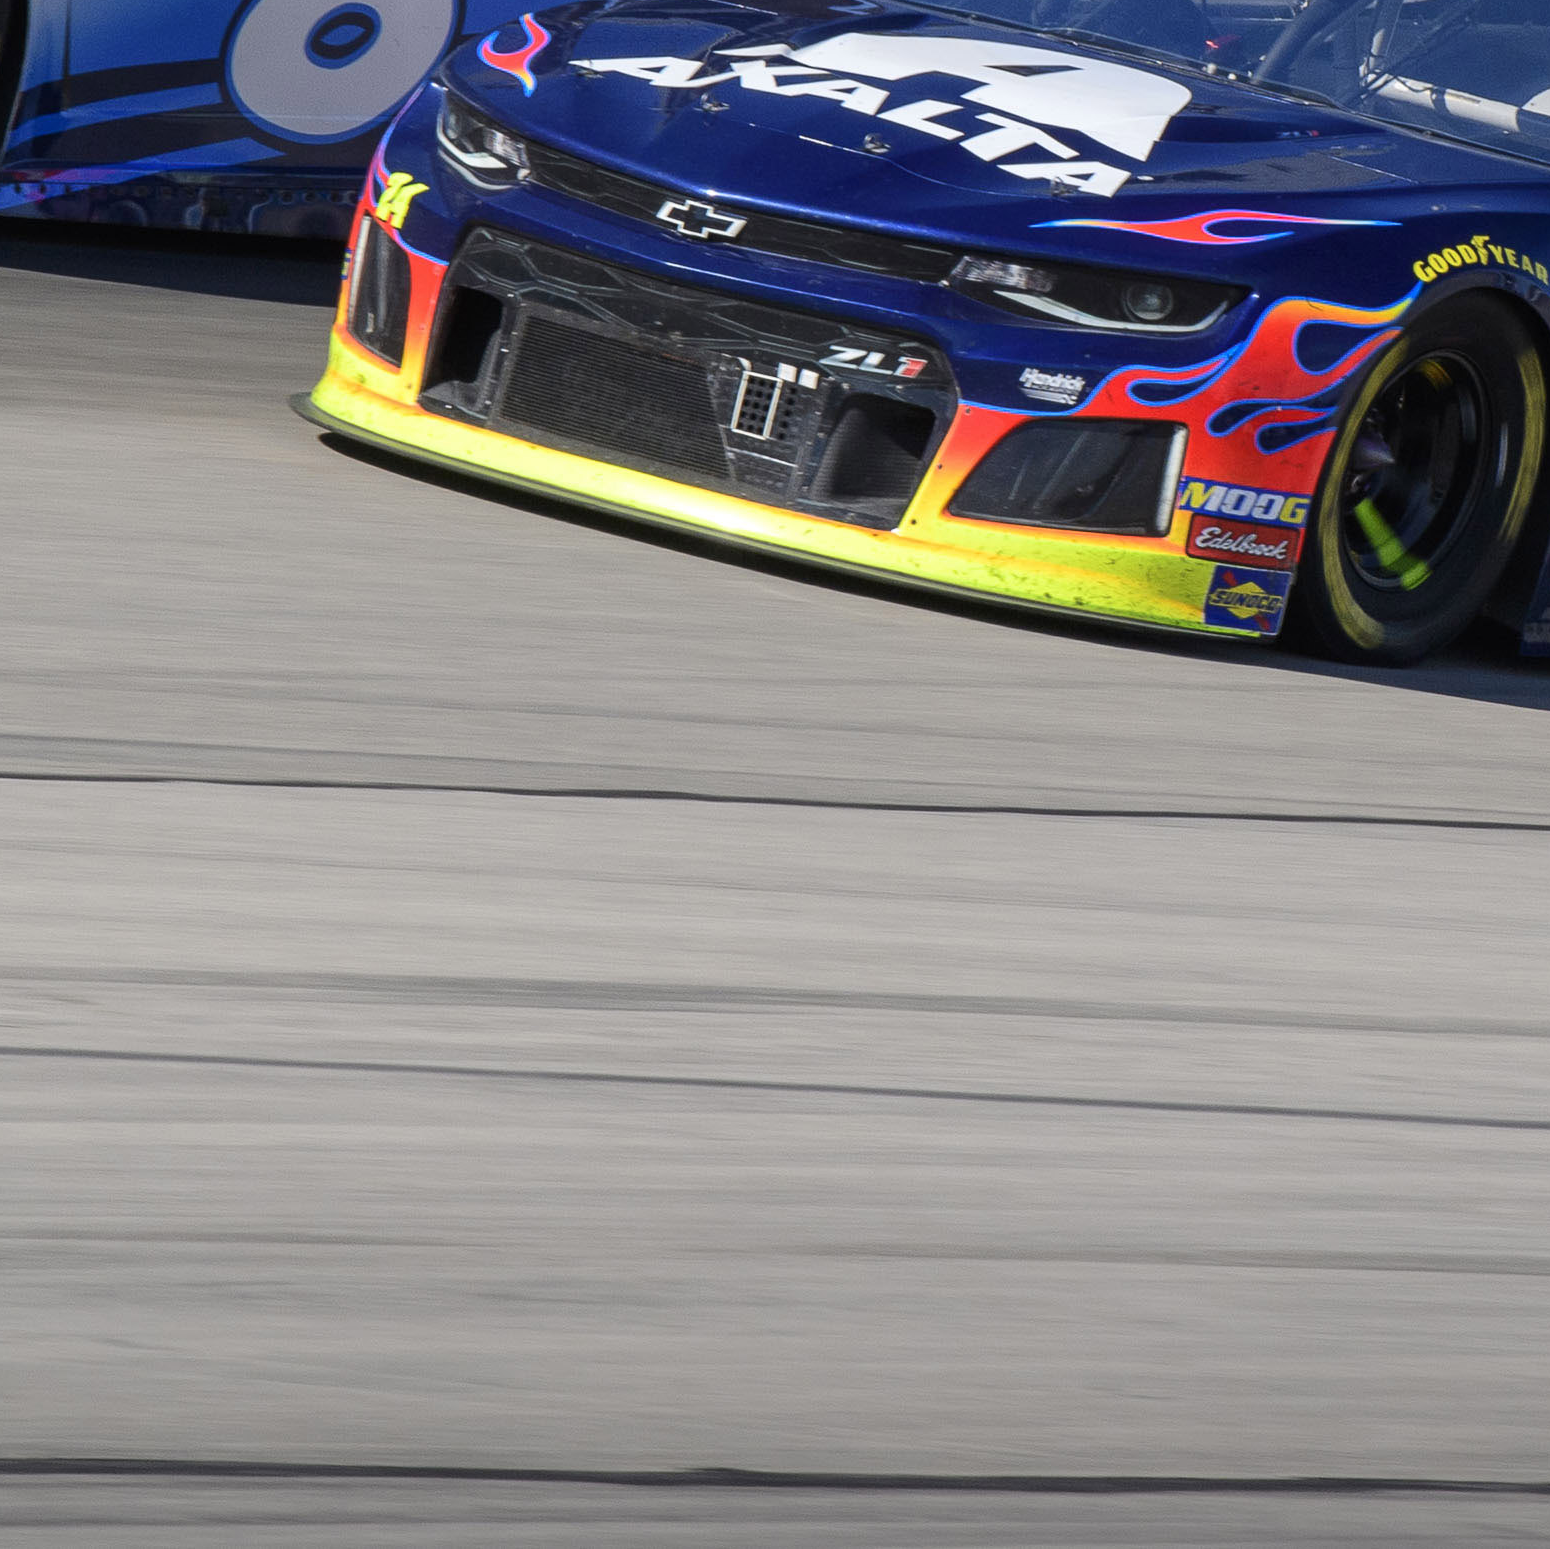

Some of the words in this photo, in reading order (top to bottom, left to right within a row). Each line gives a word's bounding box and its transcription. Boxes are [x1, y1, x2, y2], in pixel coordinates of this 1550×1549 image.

[568, 55, 1131, 198] AXALTA
[1413, 238, 1549, 286] GOODYEAR
[819, 345, 928, 379] ZL1
[1180, 481, 1311, 524] MOOG
[1195, 526, 1289, 560] Edelbrock
[1213, 589, 1281, 612] SUNOCO
